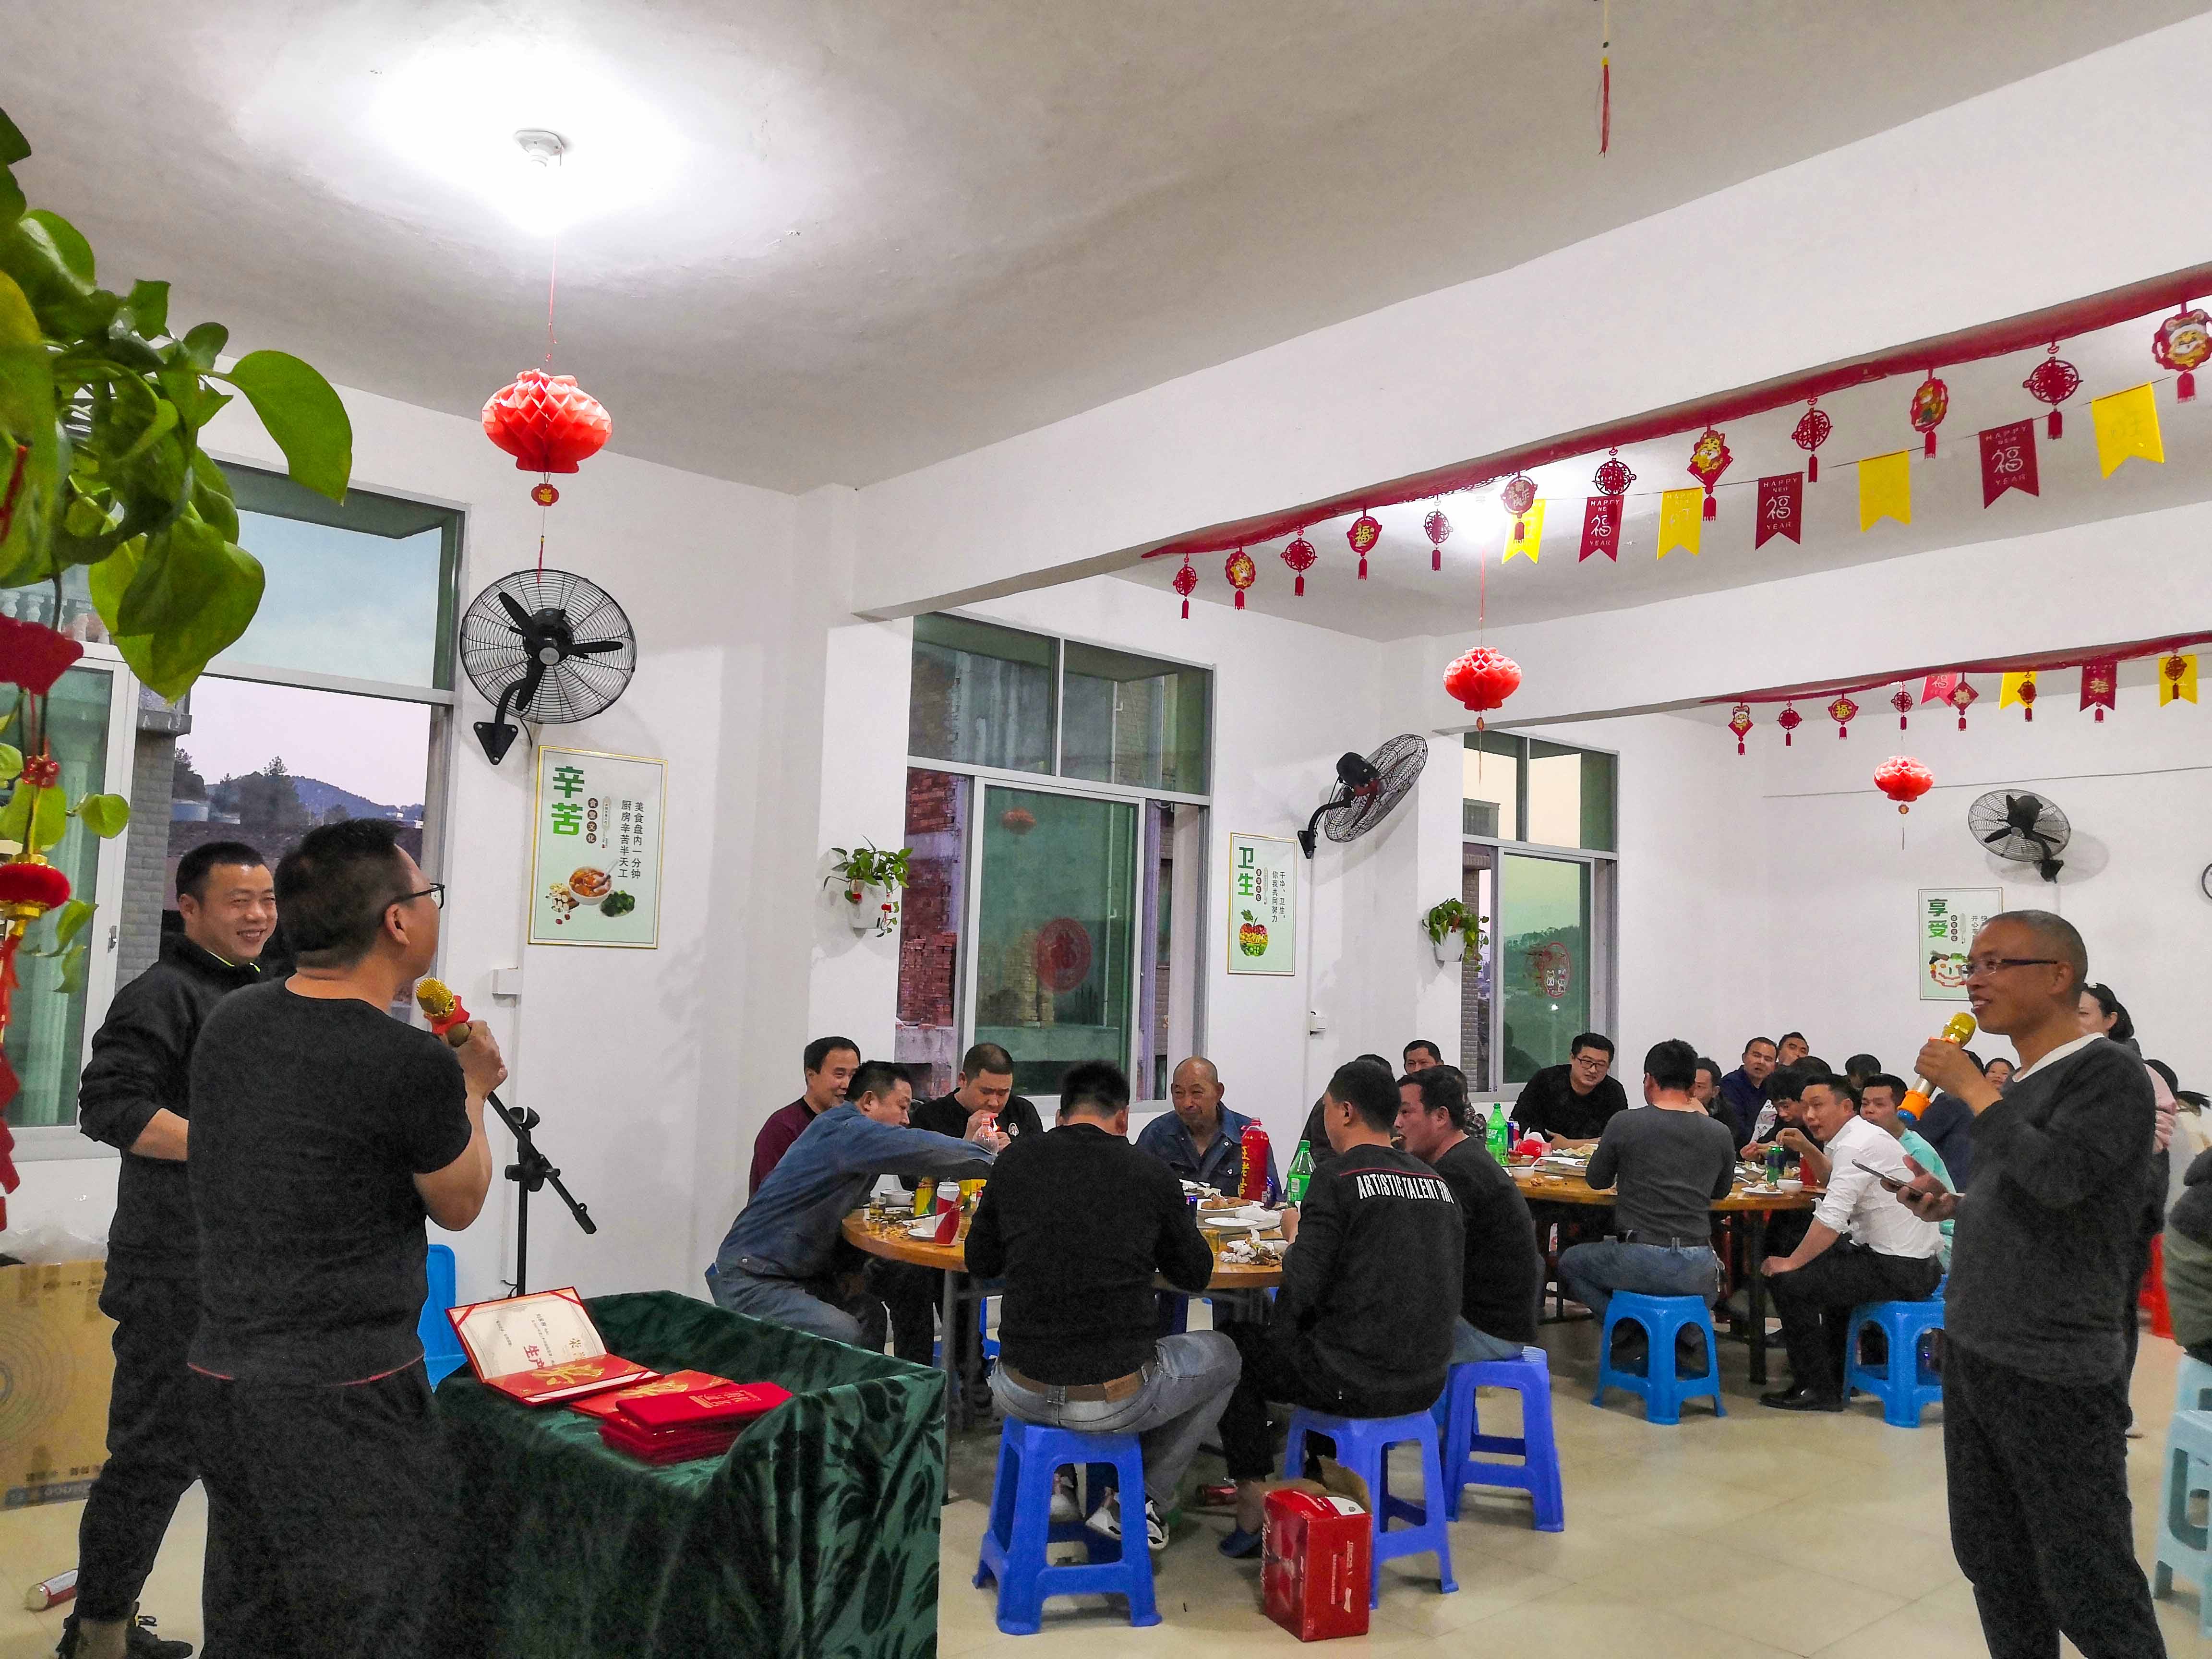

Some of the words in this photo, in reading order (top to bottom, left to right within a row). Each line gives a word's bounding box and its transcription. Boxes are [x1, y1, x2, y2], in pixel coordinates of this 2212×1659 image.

[1992, 446, 2023, 473] 福
[1764, 478, 1797, 488] HAPPY
[1591, 514, 1611, 537] 福
[1766, 496, 1791, 519] 福
[551, 766, 585, 836] 辛苦
[618, 800, 631, 878] 厨房辛苦半天工
[631, 802, 644, 878] 美食盘内一分钟
[1238, 847, 1254, 896] 卫生
[1928, 899, 1948, 938] 享受
